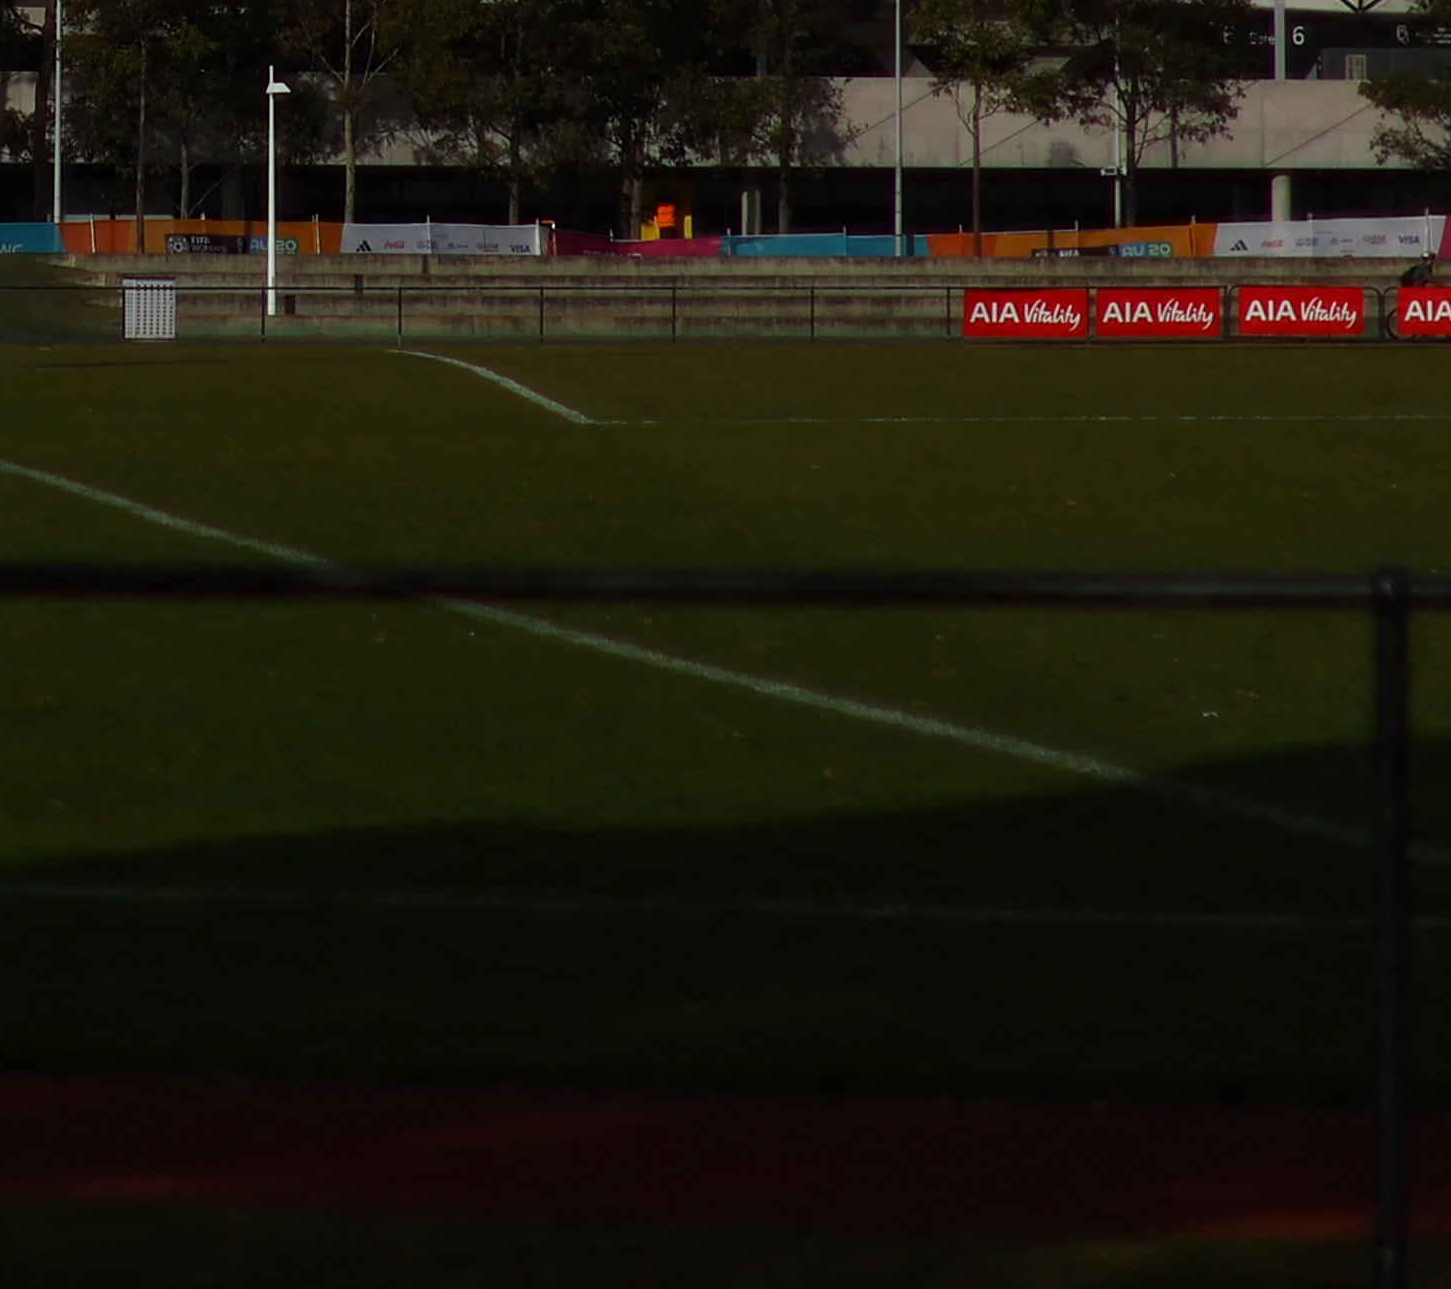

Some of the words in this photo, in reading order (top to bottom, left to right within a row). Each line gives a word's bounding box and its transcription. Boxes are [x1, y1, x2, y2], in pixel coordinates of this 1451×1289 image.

[190, 235, 212, 245] FIFA
[1398, 235, 1421, 245] VISA
[509, 244, 531, 254] VISA
[1148, 243, 1172, 256] 20
[969, 301, 1020, 323] AIA
[1024, 299, 1081, 331] Vitality
[1102, 301, 1153, 323] AIA
[1157, 298, 1214, 331] Vitality
[1245, 299, 1297, 322] AIA
[1300, 297, 1357, 330] Vitality
